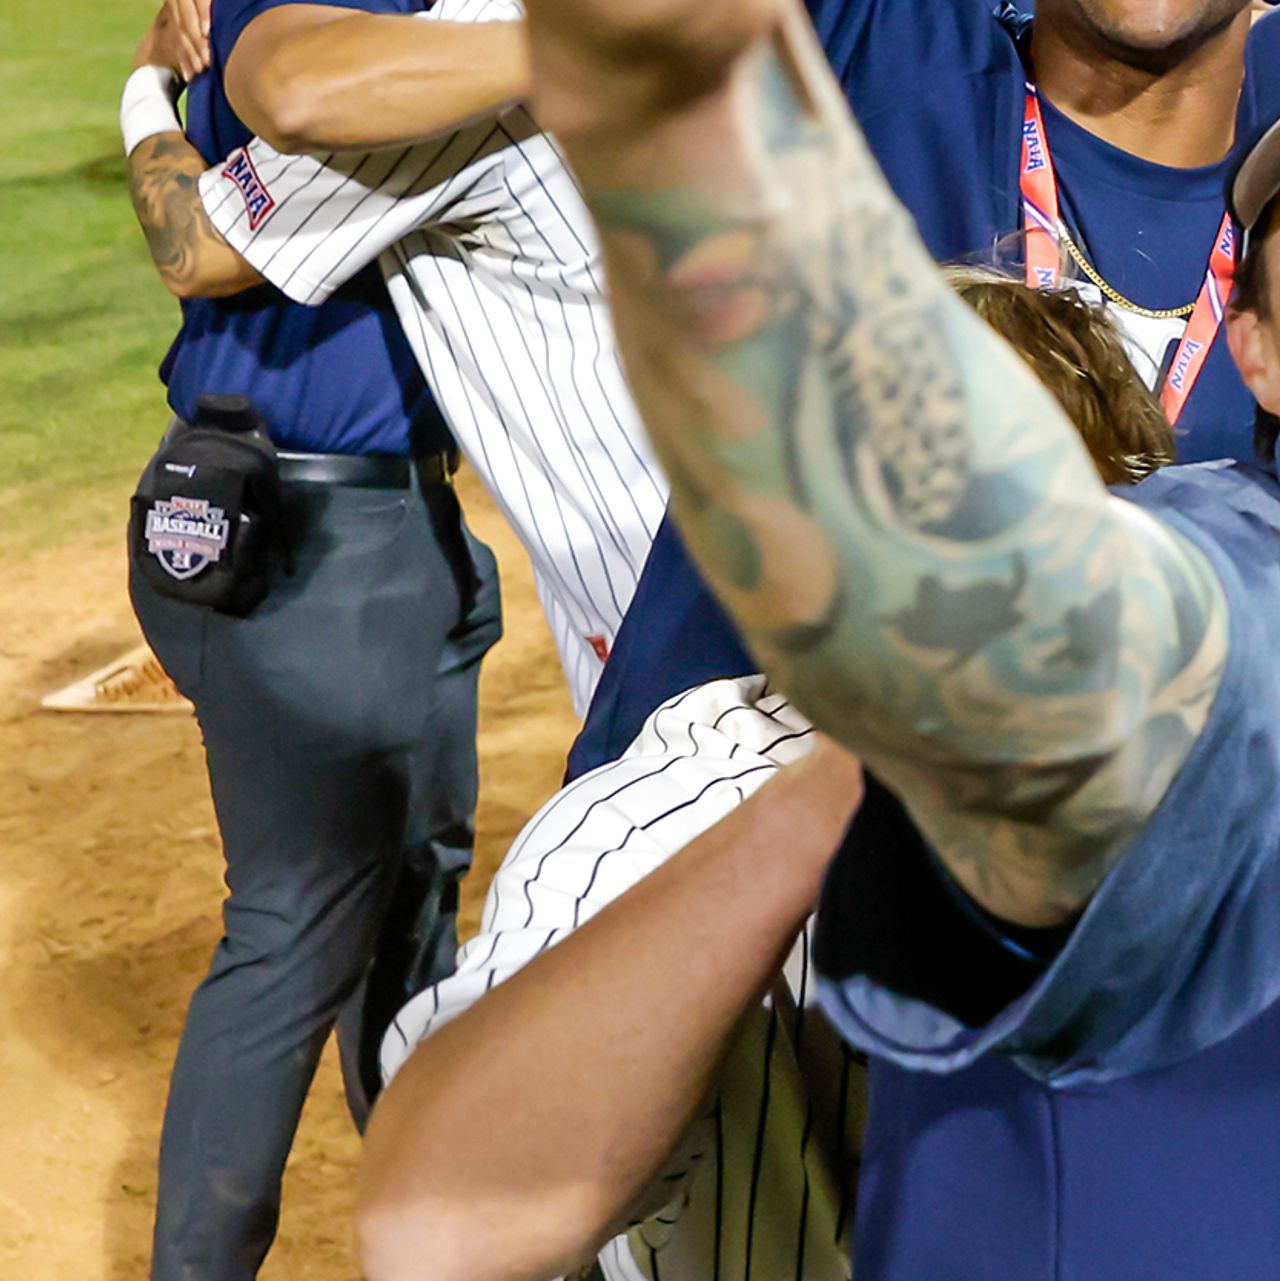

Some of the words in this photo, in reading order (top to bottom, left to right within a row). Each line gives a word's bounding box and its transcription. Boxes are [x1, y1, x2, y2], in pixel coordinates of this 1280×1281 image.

[1023, 120, 1045, 171] NAIA
[228, 153, 268, 220] NAIA
[1169, 339, 1201, 389] NAIA
[152, 516, 222, 541] BASEBALL
